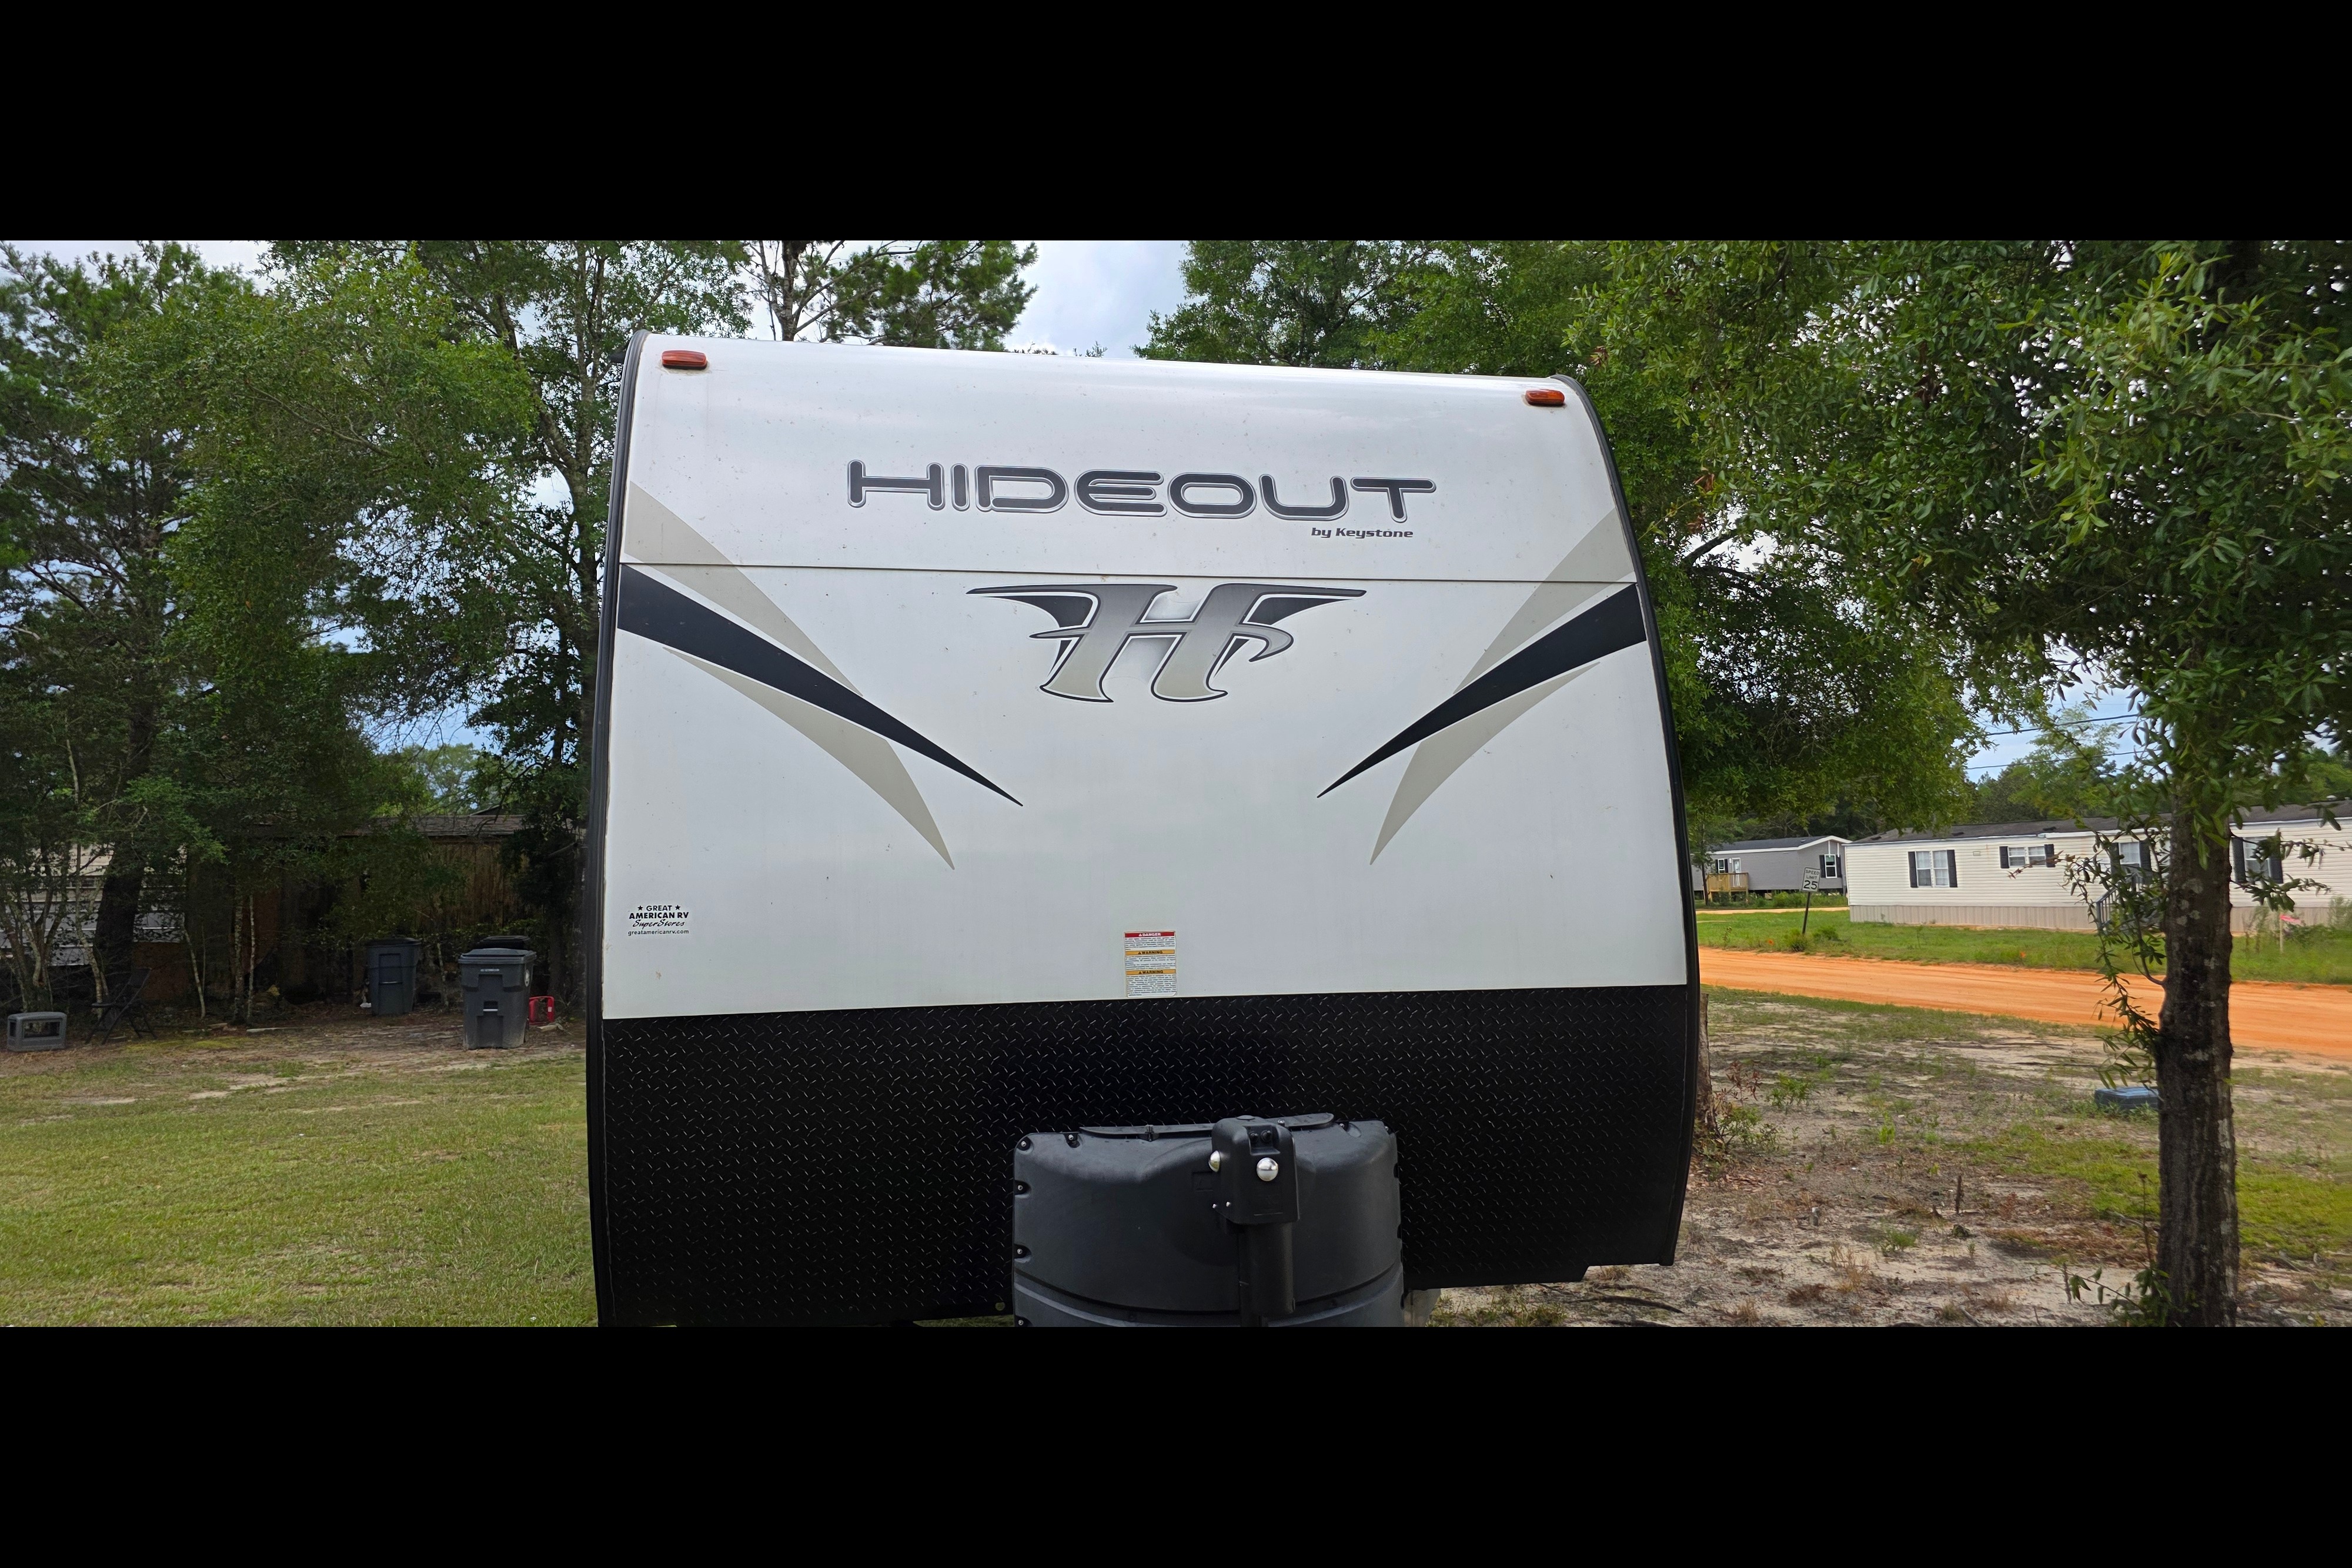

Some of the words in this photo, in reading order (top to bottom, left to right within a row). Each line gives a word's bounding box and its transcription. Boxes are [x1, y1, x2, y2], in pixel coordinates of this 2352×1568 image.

[847, 459, 1436, 523] HIDEOUT
[1311, 527, 1332, 539] by
[1335, 527, 1414, 539] Keystone
[1803, 880, 1818, 890] 25
